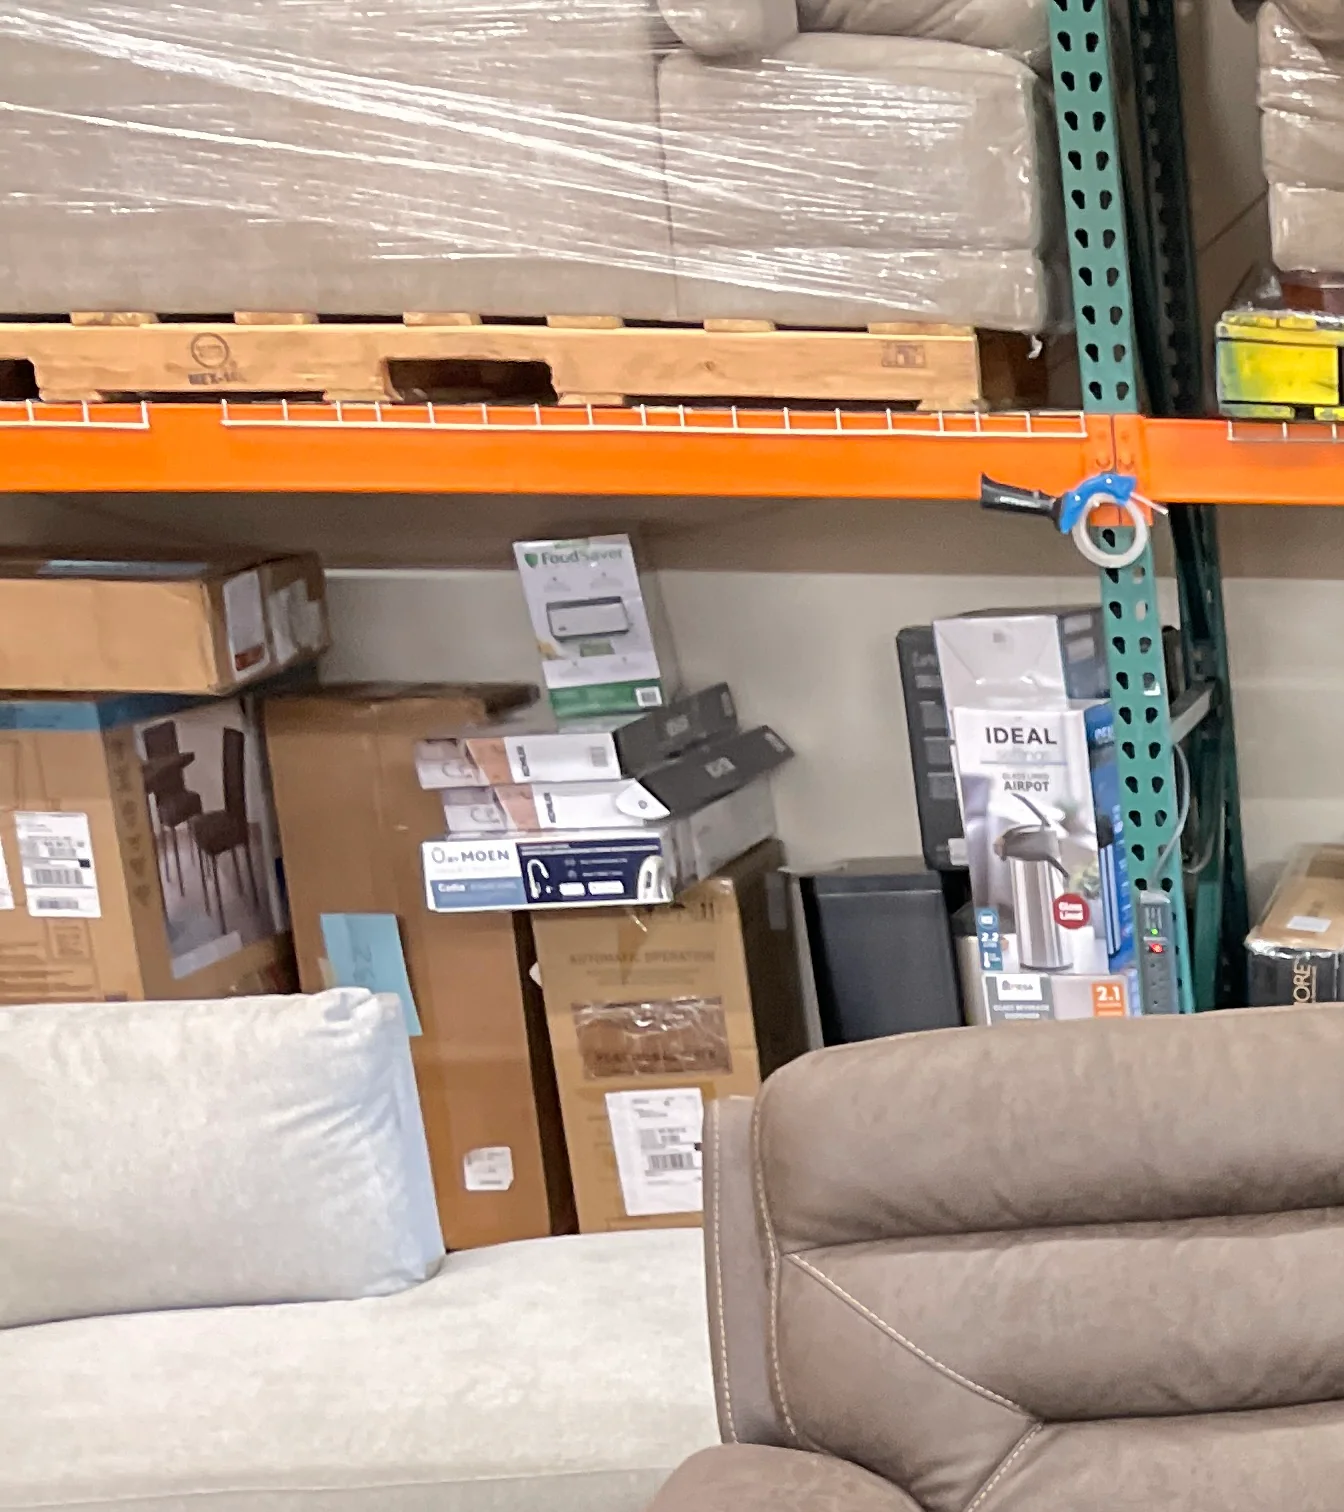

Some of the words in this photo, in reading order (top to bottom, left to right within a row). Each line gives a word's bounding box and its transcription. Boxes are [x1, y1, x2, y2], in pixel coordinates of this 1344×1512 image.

[985, 727, 1058, 745] IDEAL
[1004, 781, 1050, 792] AIRPOT
[461, 850, 510, 862] MOEN
[1096, 986, 1121, 1001] 2.1
